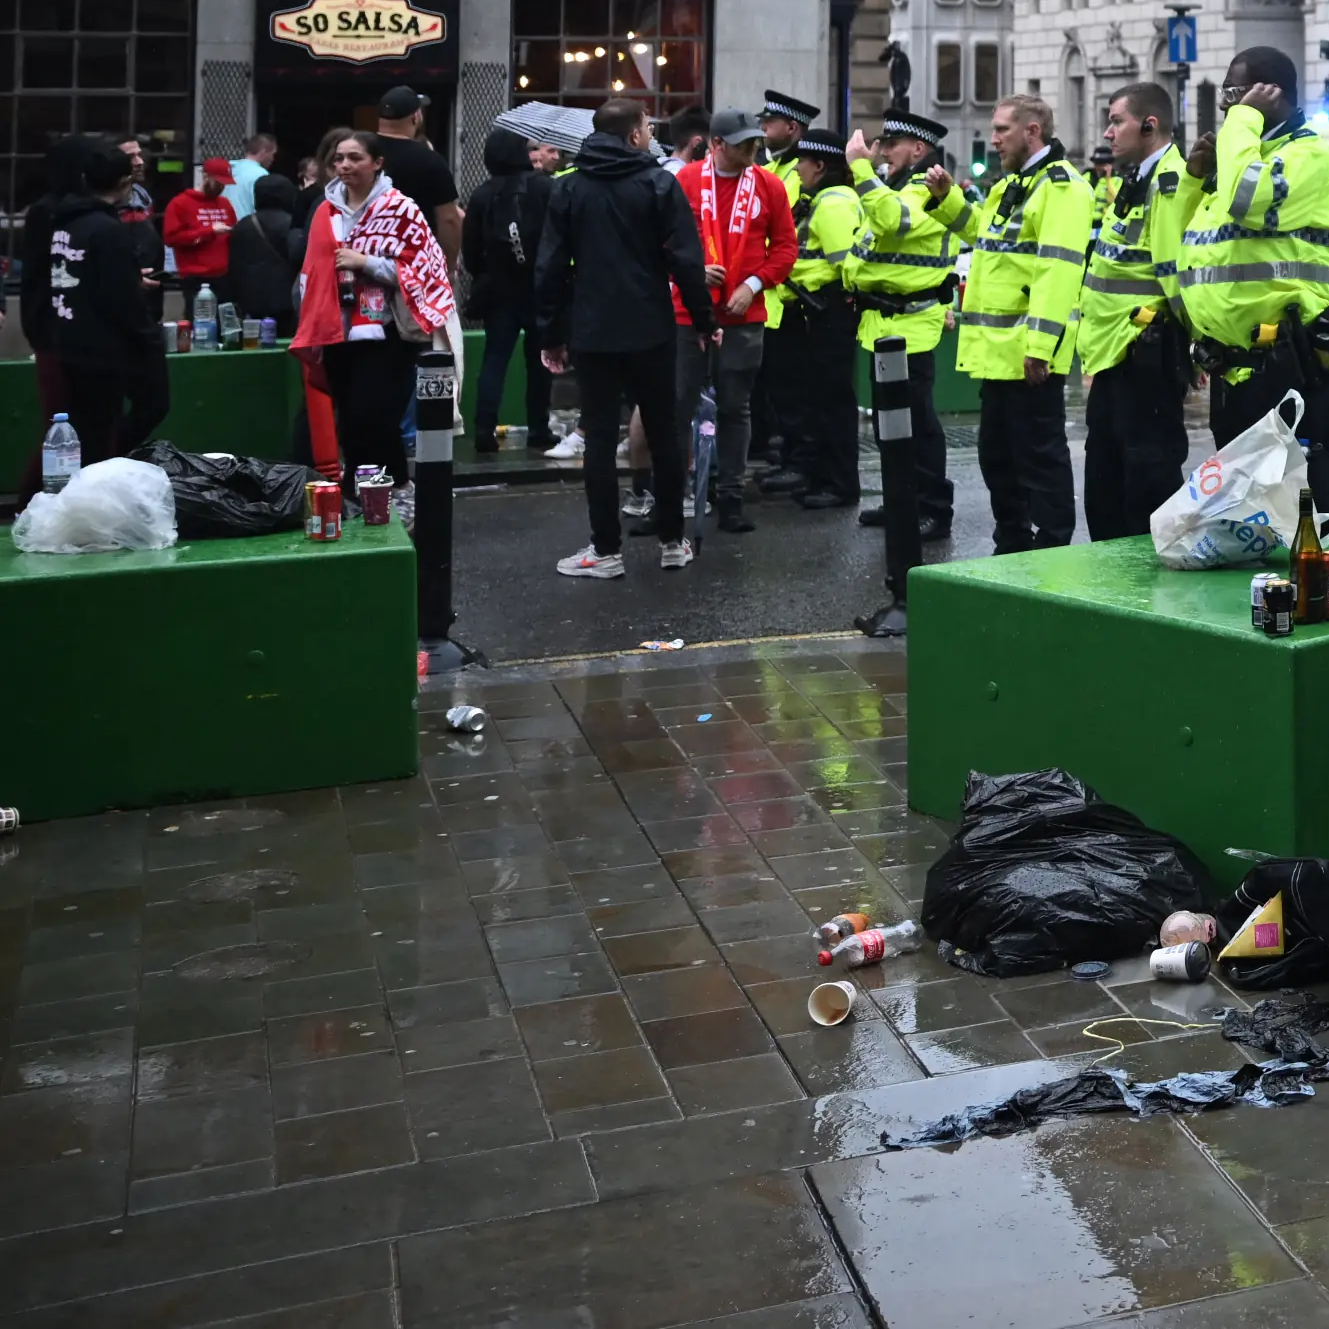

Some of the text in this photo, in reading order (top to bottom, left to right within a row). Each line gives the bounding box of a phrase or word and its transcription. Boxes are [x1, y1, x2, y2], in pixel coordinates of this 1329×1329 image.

[296, 11, 421, 36] SO SALSA
[509, 221, 526, 264] adidas
